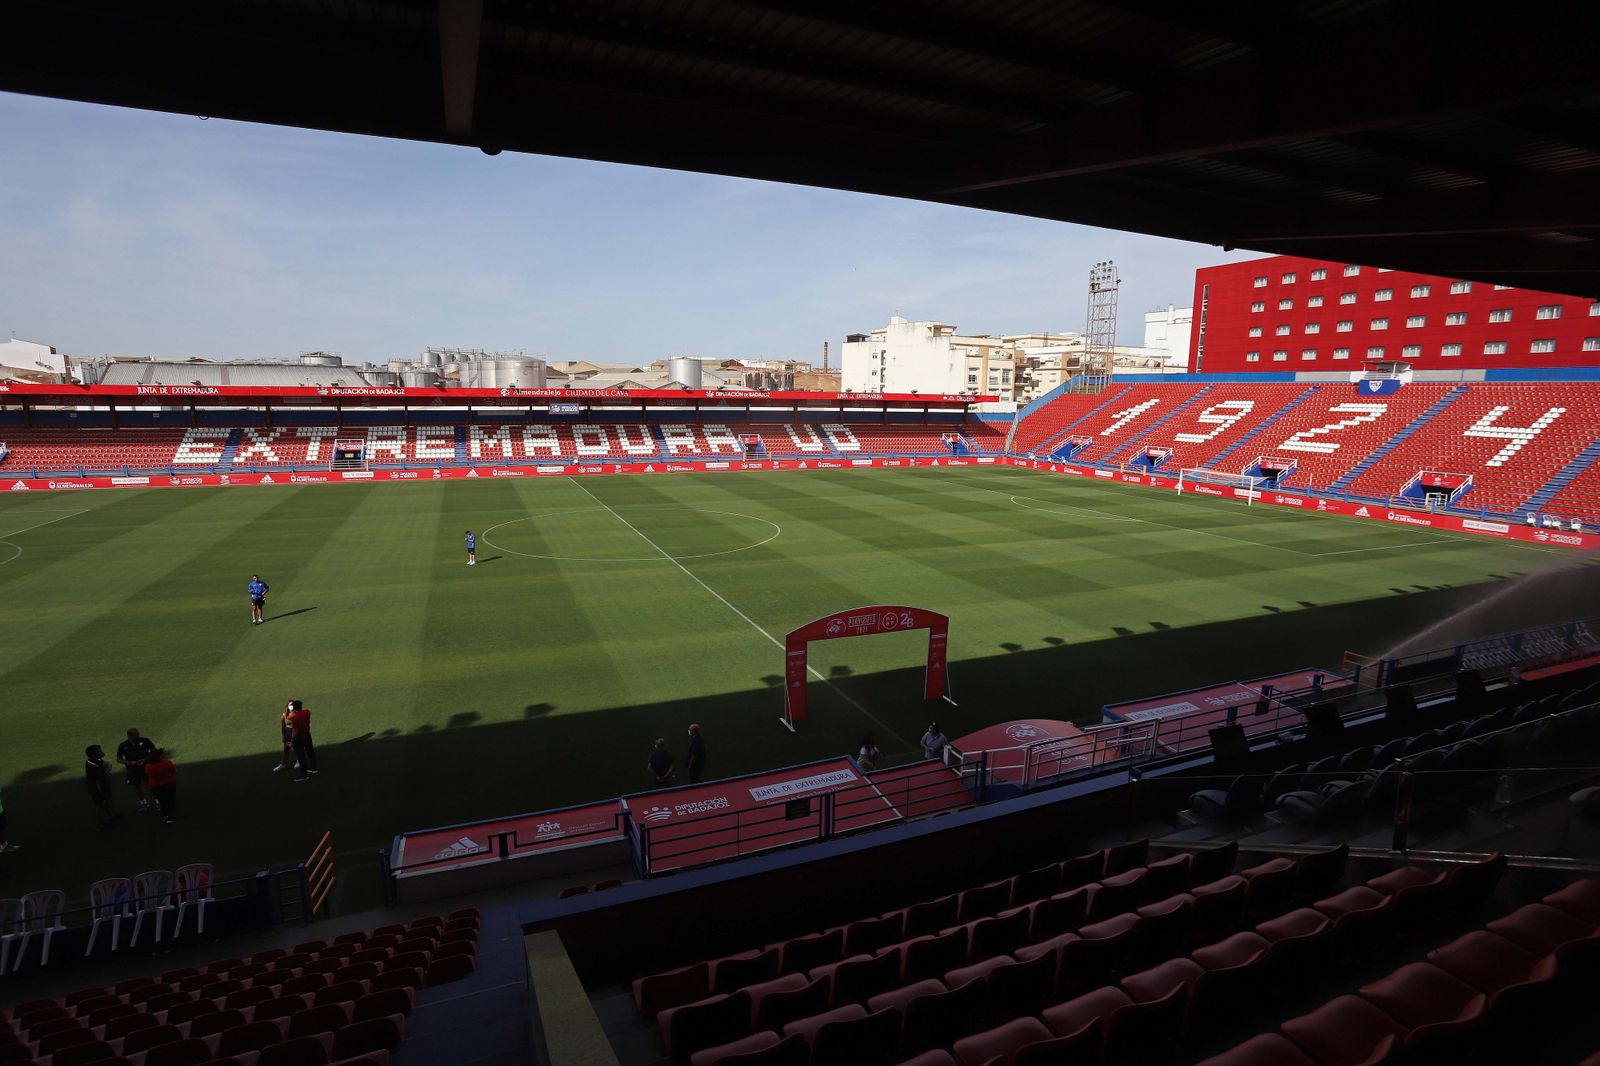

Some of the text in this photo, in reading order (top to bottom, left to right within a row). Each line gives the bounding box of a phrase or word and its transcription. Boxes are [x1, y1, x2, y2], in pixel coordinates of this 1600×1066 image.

[137, 386, 219, 395] JUNTA DE EXTREMADURA
[330, 386, 369, 395] DIPUTACIÓN
[376, 387, 405, 395] BADAJOZ
[513, 386, 629, 398] Almendralejo CIUDAD DEL CAVA
[754, 772, 851, 799] JUNTA DE EXTREMADURA
[674, 796, 728, 812] DIPUTACIÓN
[687, 802, 731, 816] BADAJOZ
[433, 846, 489, 860] adidas
